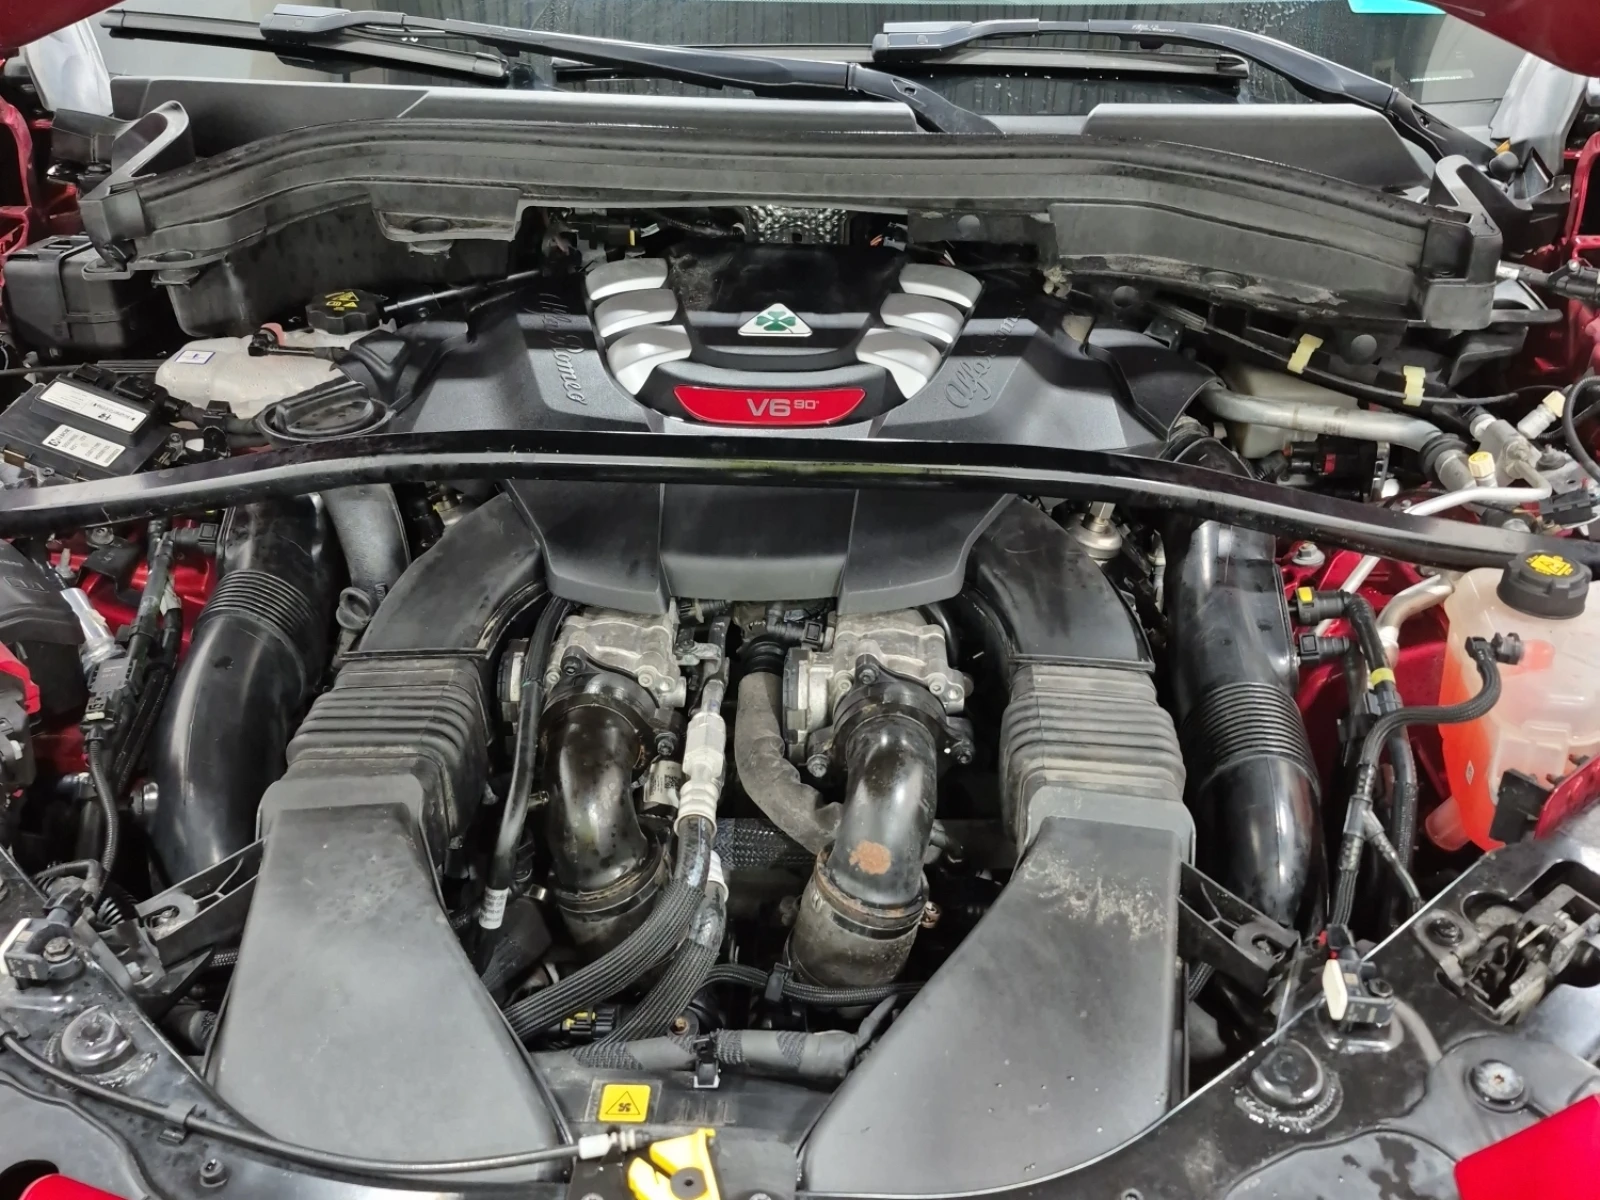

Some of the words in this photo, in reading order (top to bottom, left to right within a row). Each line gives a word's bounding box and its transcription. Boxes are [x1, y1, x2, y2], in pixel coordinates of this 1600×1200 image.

[549, 333, 588, 405] Romeo
[944, 355, 992, 408] Alfa
[746, 398, 791, 417] V6
